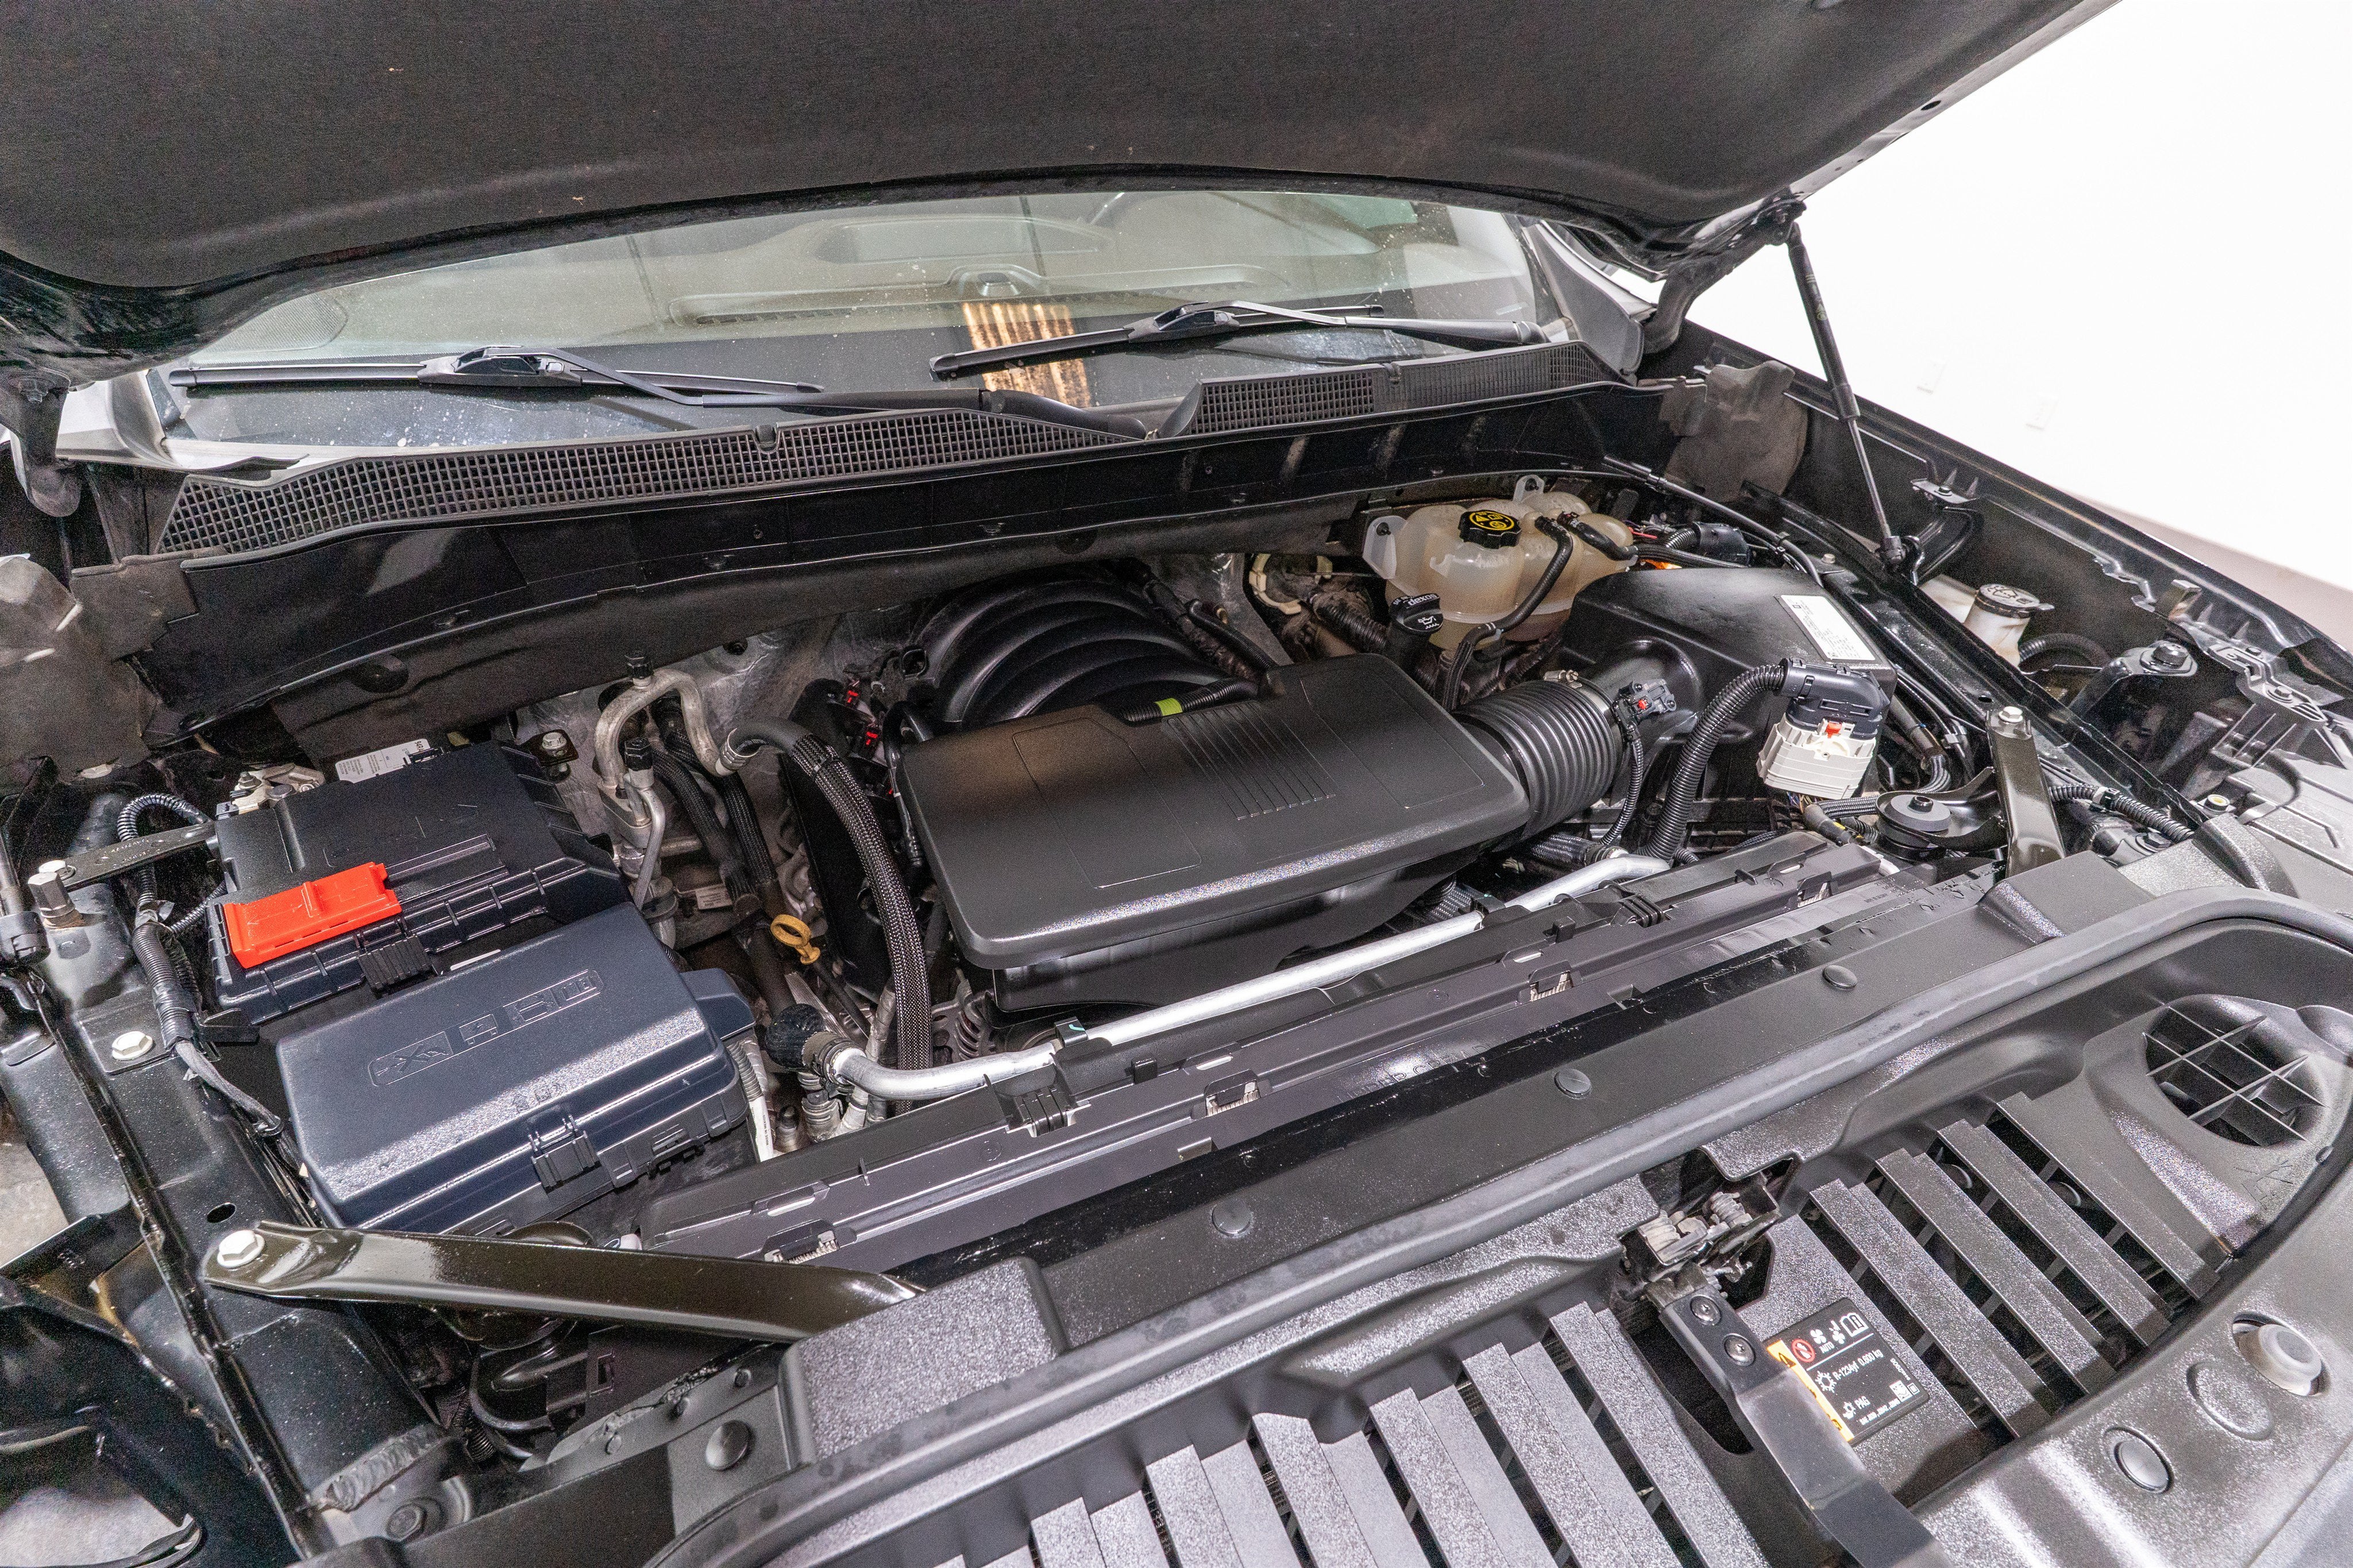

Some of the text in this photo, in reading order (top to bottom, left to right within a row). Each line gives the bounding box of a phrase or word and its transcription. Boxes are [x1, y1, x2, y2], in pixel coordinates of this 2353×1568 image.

[1407, 593, 1437, 606] dexos
[1819, 1341, 1835, 1354] AUTO
[1871, 1349, 1884, 1358] kg
[1854, 1395, 1871, 1410] PAG
